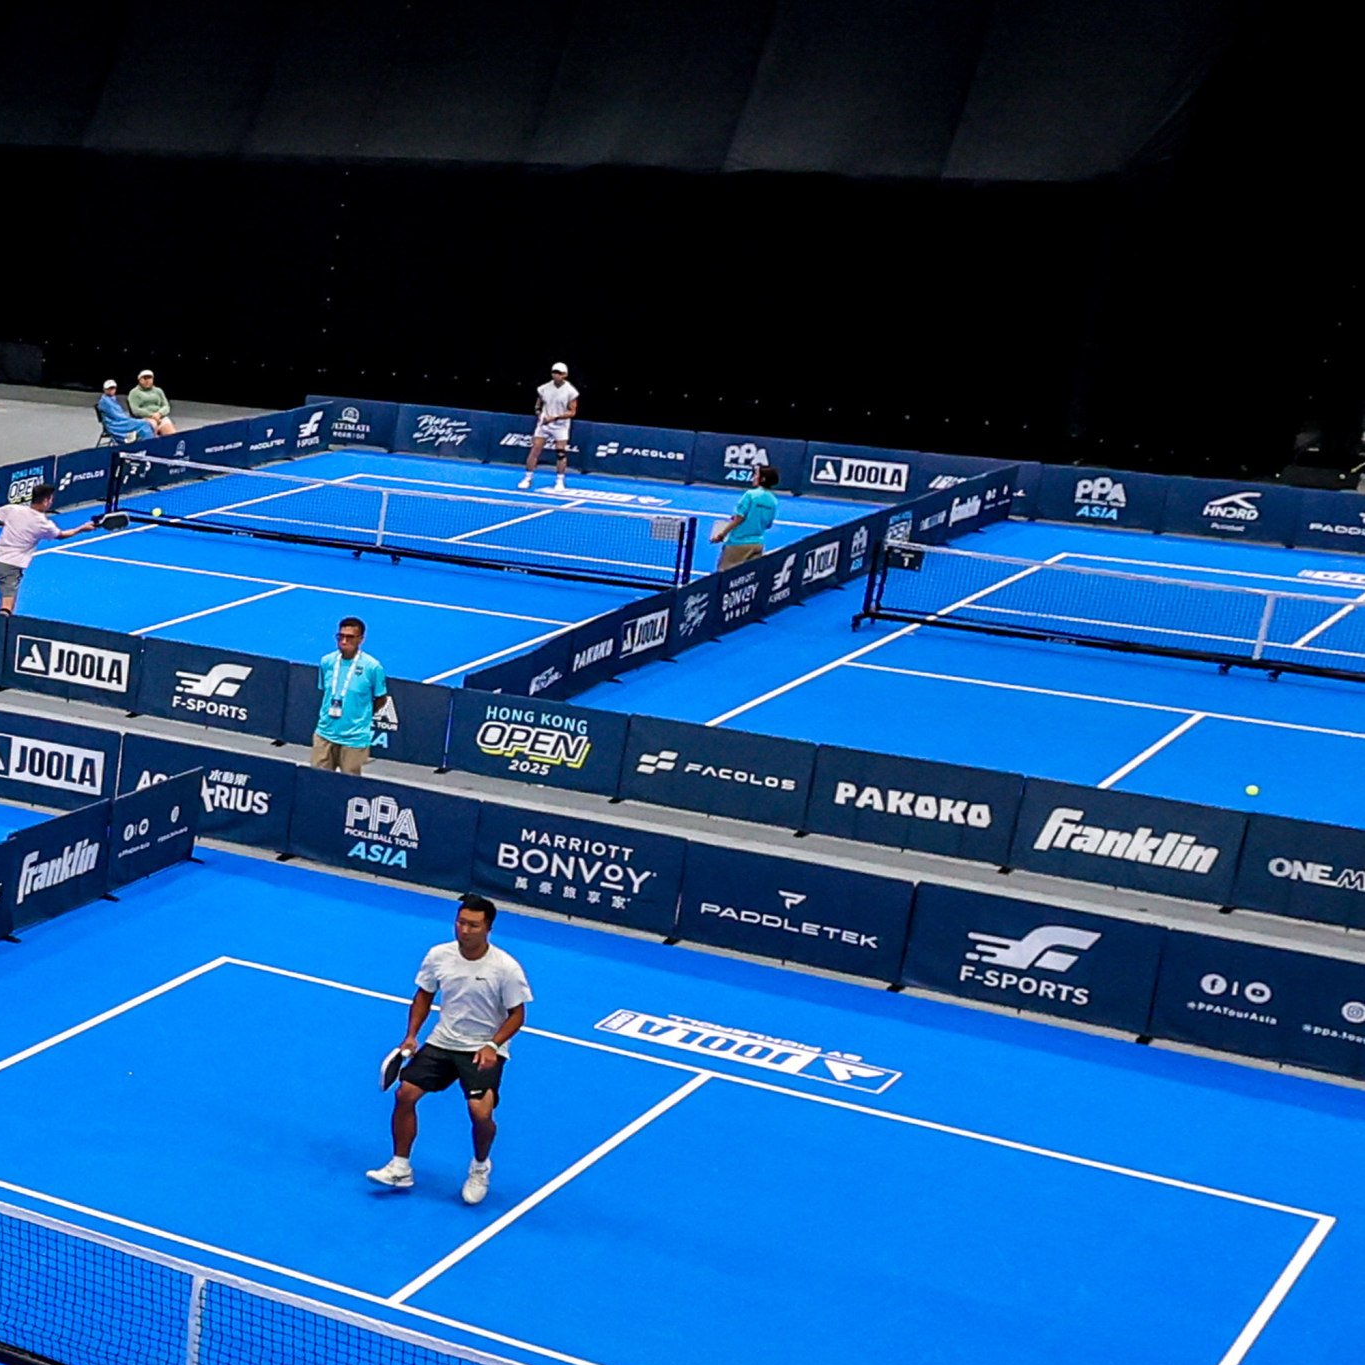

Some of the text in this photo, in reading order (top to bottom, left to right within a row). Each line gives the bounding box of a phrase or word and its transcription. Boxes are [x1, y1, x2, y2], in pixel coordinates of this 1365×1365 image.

[622, 447, 685, 460] FACOLOS
[844, 465, 903, 486] JOOLA
[1074, 476, 1126, 505] PPA
[1075, 505, 1118, 521] ASIA
[54, 649, 125, 693] JOOLA
[172, 695, 248, 721] F-SPORTS
[485, 705, 588, 735] HONG KONG
[476, 721, 591, 769] OPEN
[14, 746, 97, 787] JOOLA
[508, 758, 551, 776] 2025
[683, 762, 797, 792] FACOLOS
[346, 796, 419, 842] PPA
[834, 781, 992, 829] PAKOKO
[344, 826, 419, 850] PICKLEBALL TOUR
[520, 829, 634, 861] MARRIOTT
[348, 840, 409, 869] ASIA
[496, 842, 652, 895] BONVOY
[699, 902, 879, 949] PADDLETEK
[960, 964, 1090, 1006] F-SPORTS
